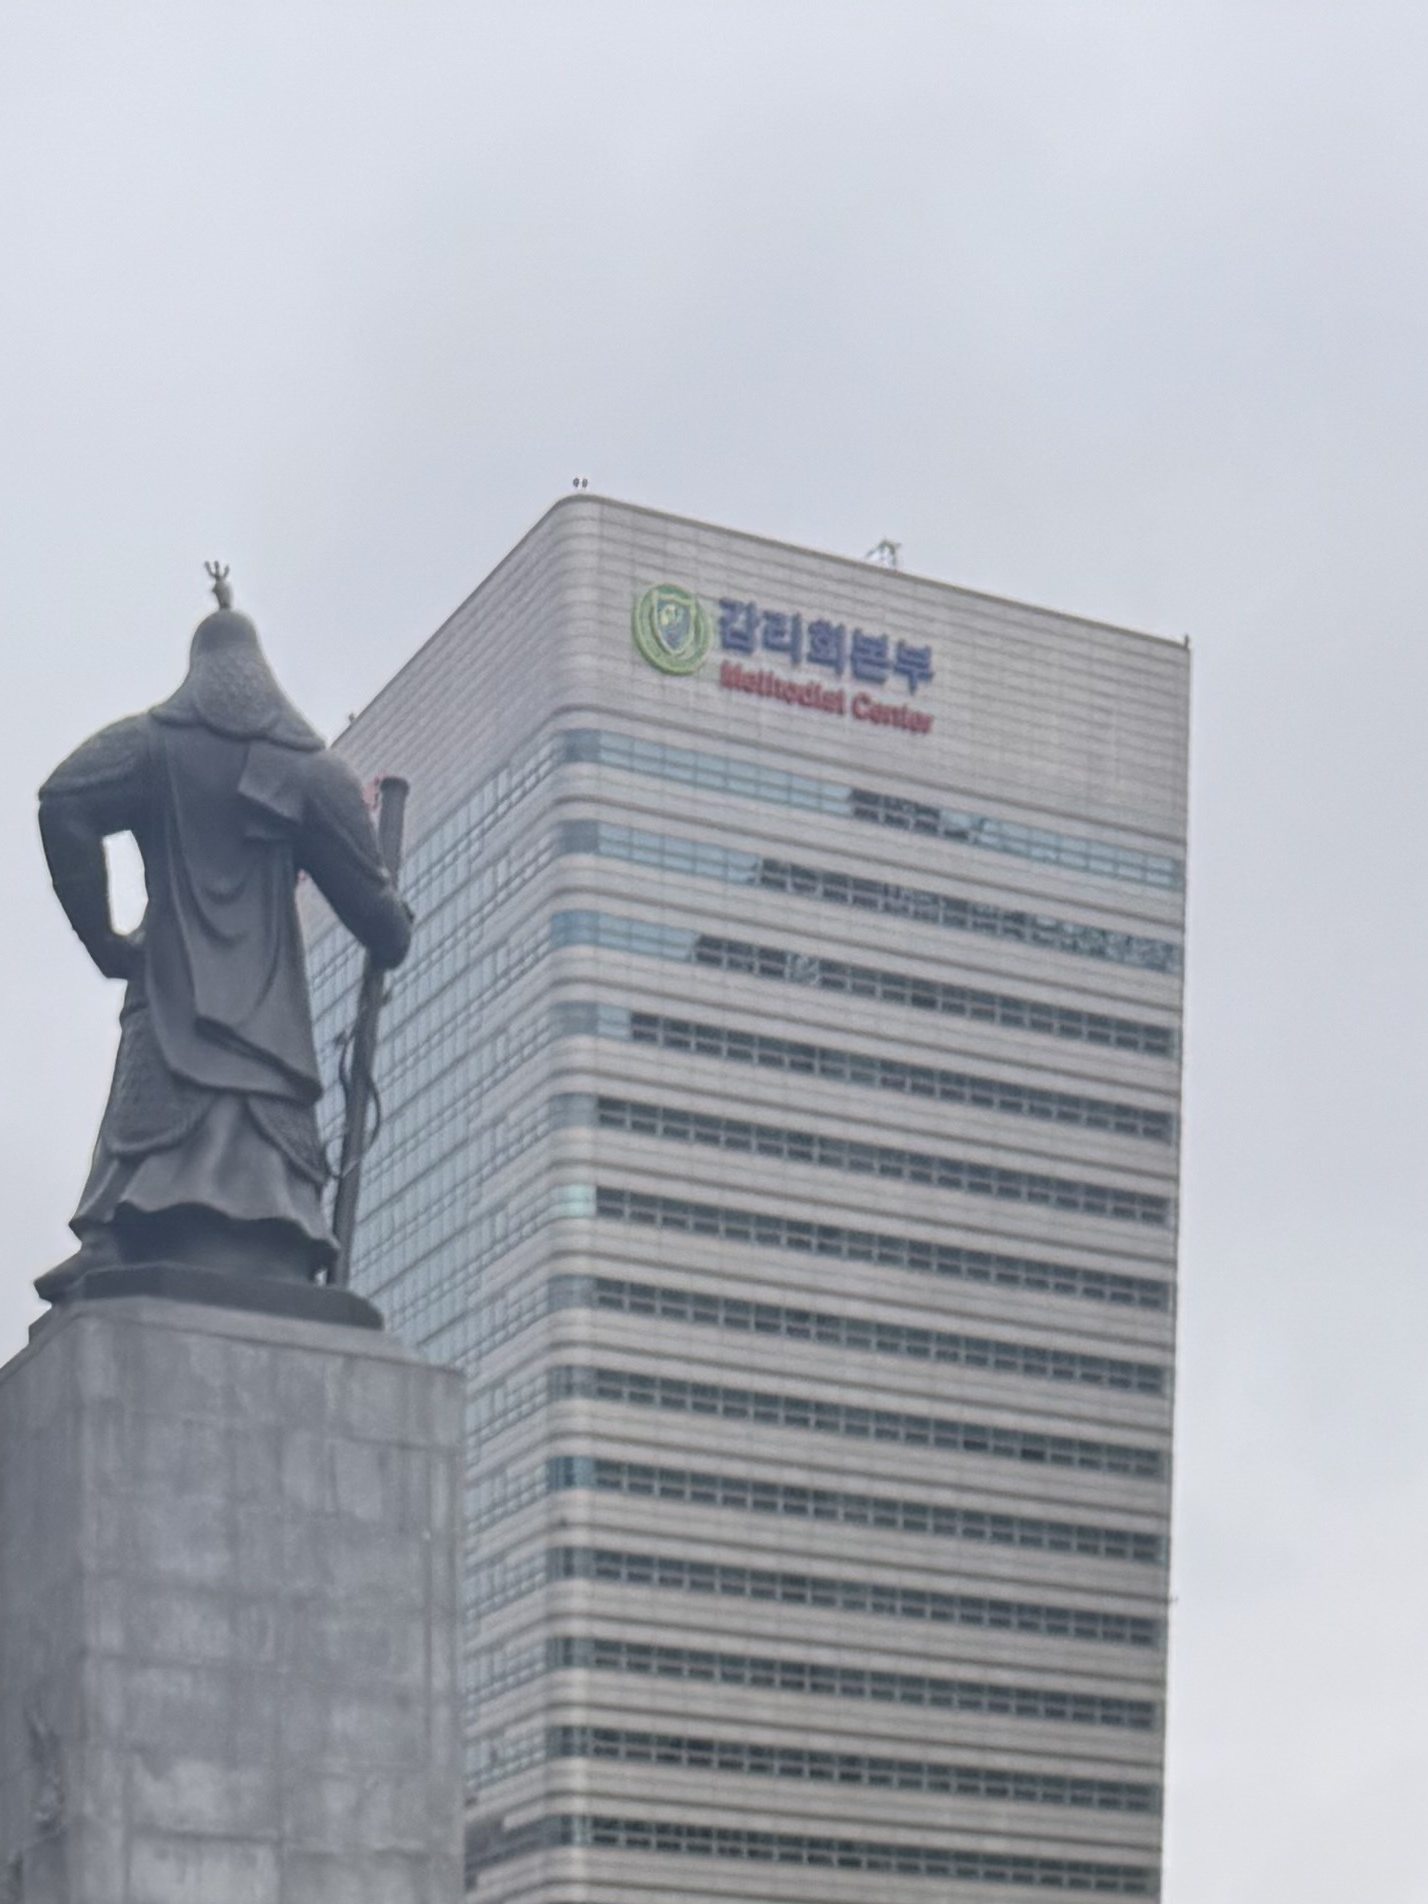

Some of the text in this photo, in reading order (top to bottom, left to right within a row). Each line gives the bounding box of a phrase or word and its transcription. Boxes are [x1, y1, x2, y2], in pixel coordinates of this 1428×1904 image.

[718, 598, 934, 695] 감리회본부
[720, 659, 933, 734] Methodist Center
